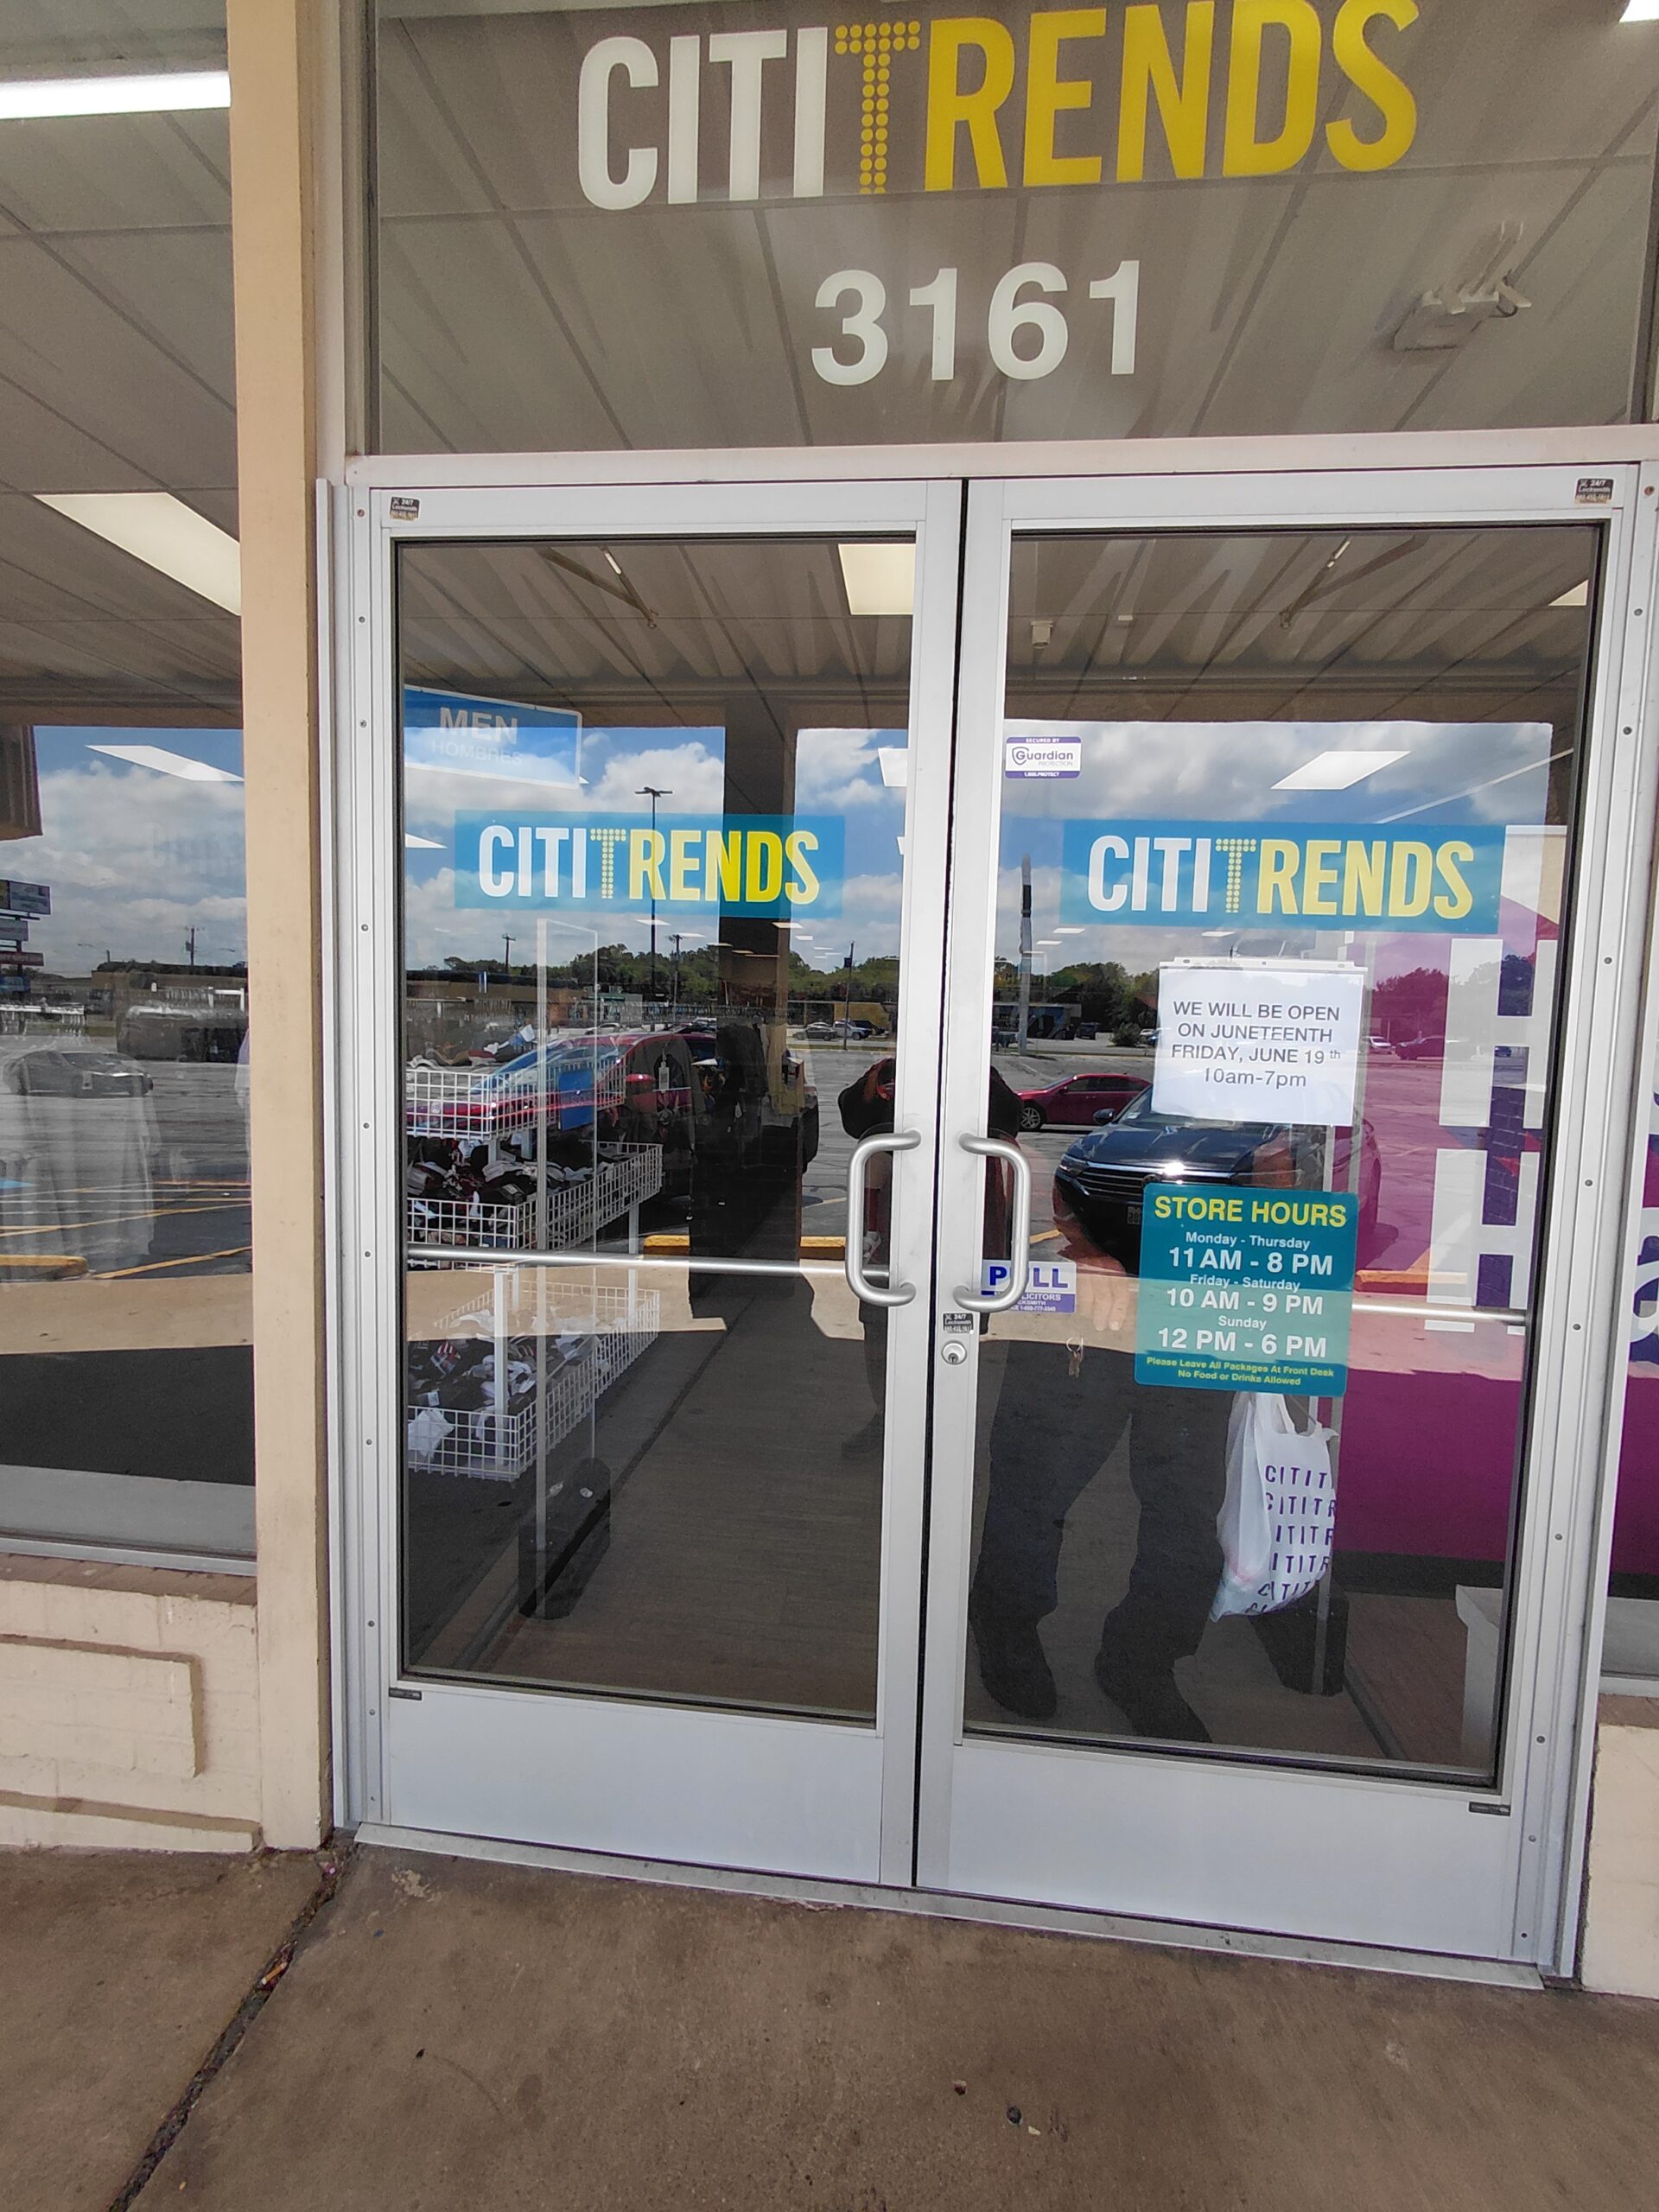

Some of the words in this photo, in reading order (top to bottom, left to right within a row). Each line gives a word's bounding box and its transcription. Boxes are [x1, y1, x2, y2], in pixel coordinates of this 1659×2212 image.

[810, 260, 1140, 387] 3161
[440, 707, 518, 745] MEN
[432, 739, 523, 766] HOMBRES
[1015, 750, 1073, 760] Guardian
[479, 825, 820, 906] CITITRENDS
[1088, 835, 1474, 919] CITITRENDS
[1173, 1001, 1203, 1015] WE
[1209, 1002, 1252, 1018] WILL
[1258, 1005, 1283, 1019] BE
[1287, 1005, 1340, 1020] OPEN
[1178, 1023, 1205, 1037] ON
[1211, 1024, 1332, 1043] JUNETEENTH
[1172, 1044, 1243, 1063] FRIDAY,
[1249, 1047, 1299, 1064] JUNE
[1305, 1050, 1325, 1065] 19
[1205, 1067, 1306, 1089] 10am-7pm
[1154, 1196, 1243, 1223] STORE
[1251, 1201, 1346, 1228] HOURS
[1185, 1231, 1237, 1248] Monday
[1249, 1235, 1311, 1252] Thursday
[1267, 1252, 1283, 1274] 8
[1292, 1254, 1333, 1276] PM
[989, 1266, 1069, 1288] PLL
[1190, 1274, 1230, 1287] Friday
[1243, 1277, 1300, 1293] Saturday
[1021, 1293, 1062, 1301] LICITORS
[1166, 1288, 1194, 1307] 10
[1201, 1290, 1240, 1310] AM
[1262, 1293, 1278, 1313] 9
[1285, 1294, 1324, 1315] PM
[1218, 1315, 1268, 1331] Sunday
[1158, 1327, 1188, 1349] 12
[1196, 1329, 1236, 1352] PM
[1261, 1333, 1277, 1355] 6
[1286, 1336, 1326, 1358] PM
[1147, 1356, 1177, 1367] Please
[1179, 1358, 1207, 1369] Leave
[1209, 1360, 1221, 1370] All
[1224, 1362, 1268, 1374] Packages
[1270, 1364, 1281, 1373] At
[1283, 1365, 1307, 1376] Front
[1310, 1367, 1334, 1377] Desk
[1178, 1369, 1191, 1378] No
[1193, 1370, 1217, 1381] Food
[1231, 1372, 1262, 1383] Drinks
[1264, 1374, 1301, 1386] Allowed
